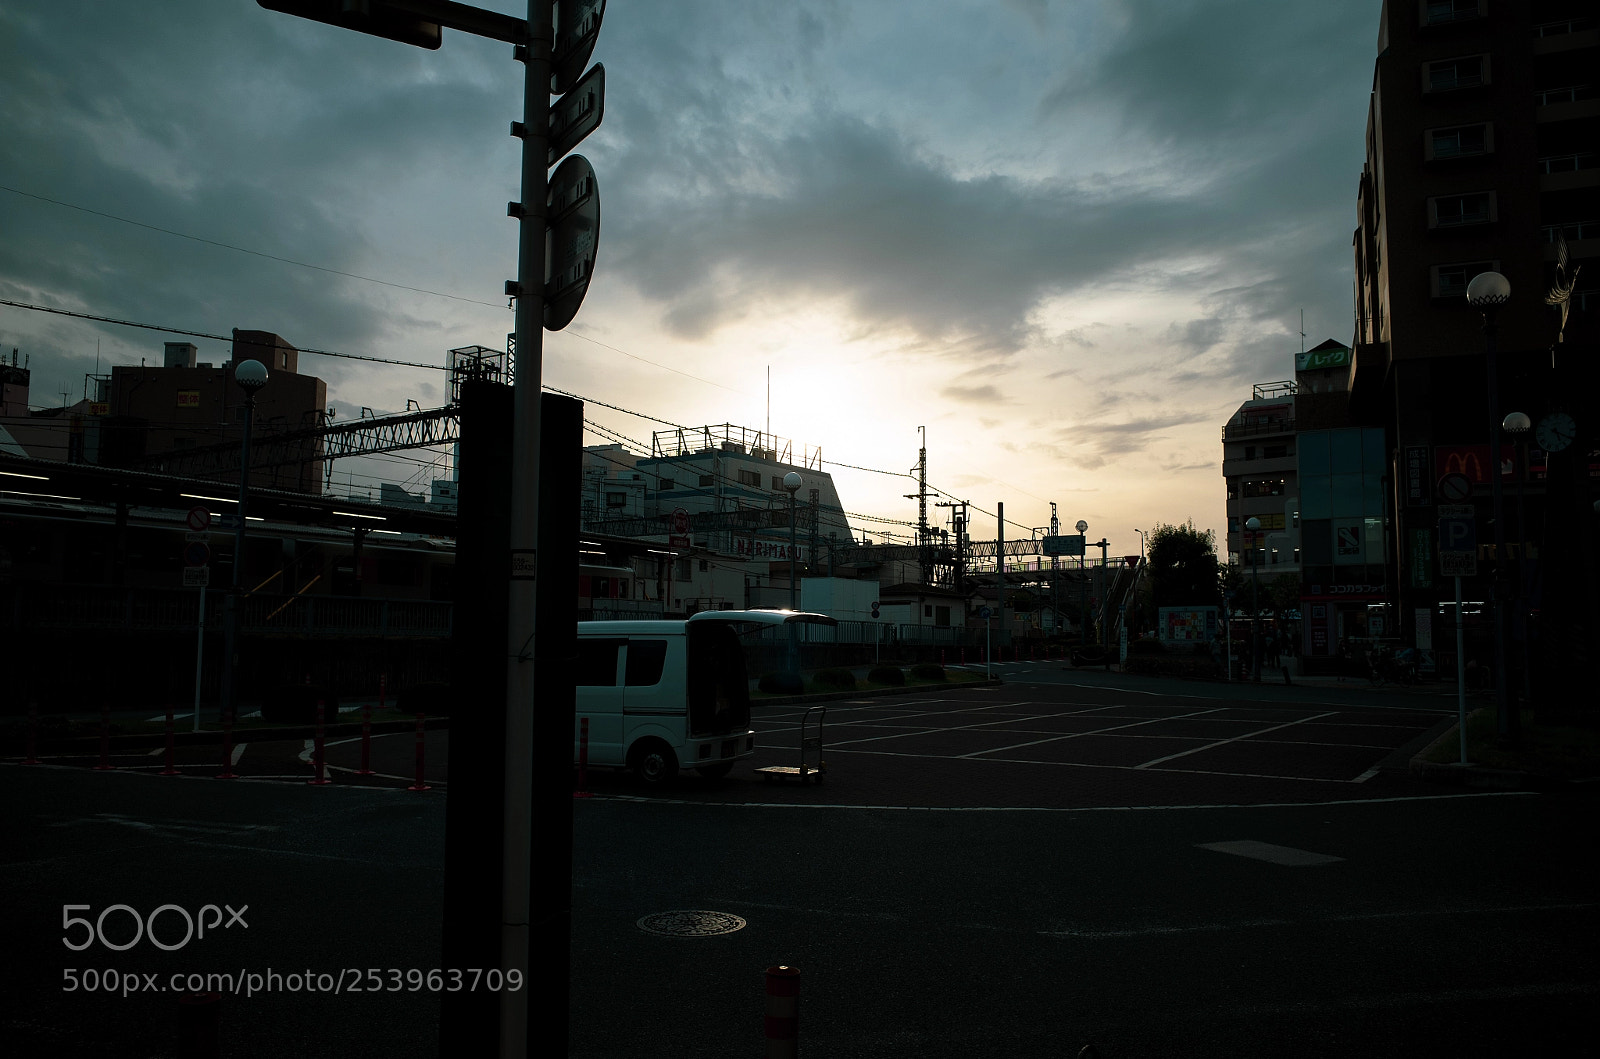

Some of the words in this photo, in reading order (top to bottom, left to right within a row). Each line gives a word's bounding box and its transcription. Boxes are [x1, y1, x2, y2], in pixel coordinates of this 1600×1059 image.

[1314, 351, 1345, 365] レイク
[1448, 521, 1469, 548] P
[737, 539, 803, 559] NARIMASU
